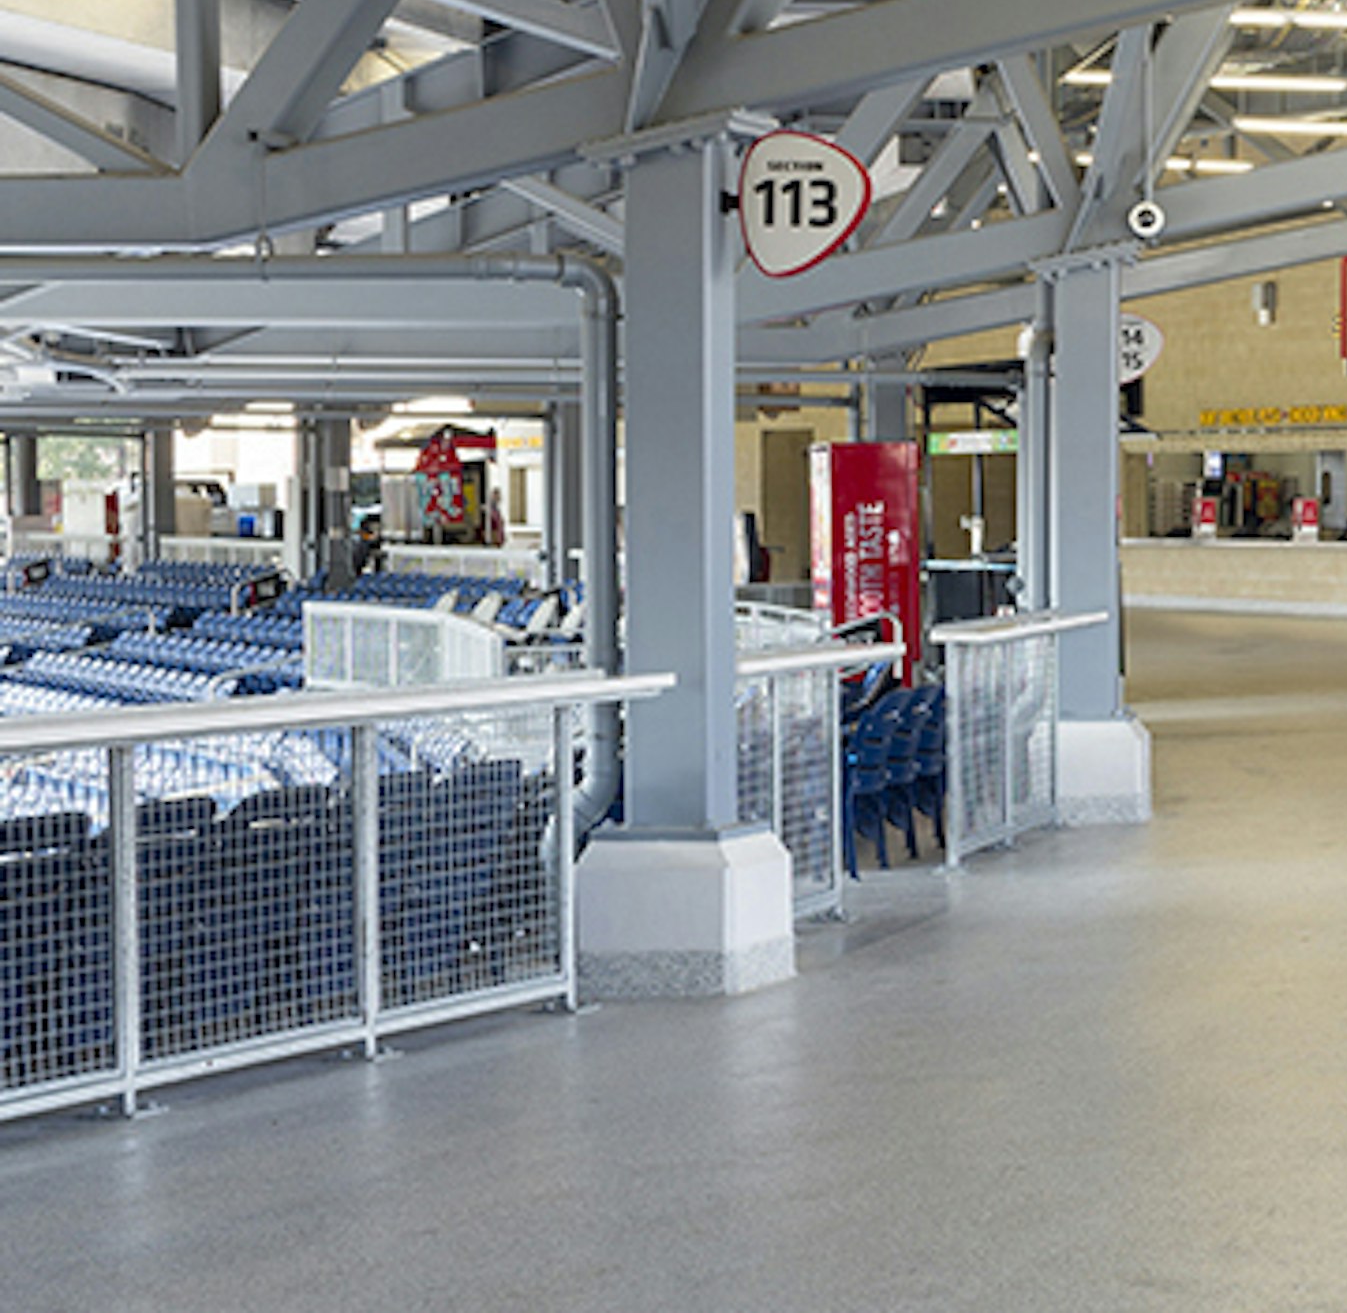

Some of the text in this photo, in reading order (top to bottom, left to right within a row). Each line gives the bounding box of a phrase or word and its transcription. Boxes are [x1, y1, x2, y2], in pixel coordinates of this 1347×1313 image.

[767, 161, 824, 172] SECTION
[754, 179, 838, 228] 113
[1121, 327, 1144, 347] 14
[1121, 351, 1144, 371] 15
[856, 500, 886, 616] OOTH TASTE
